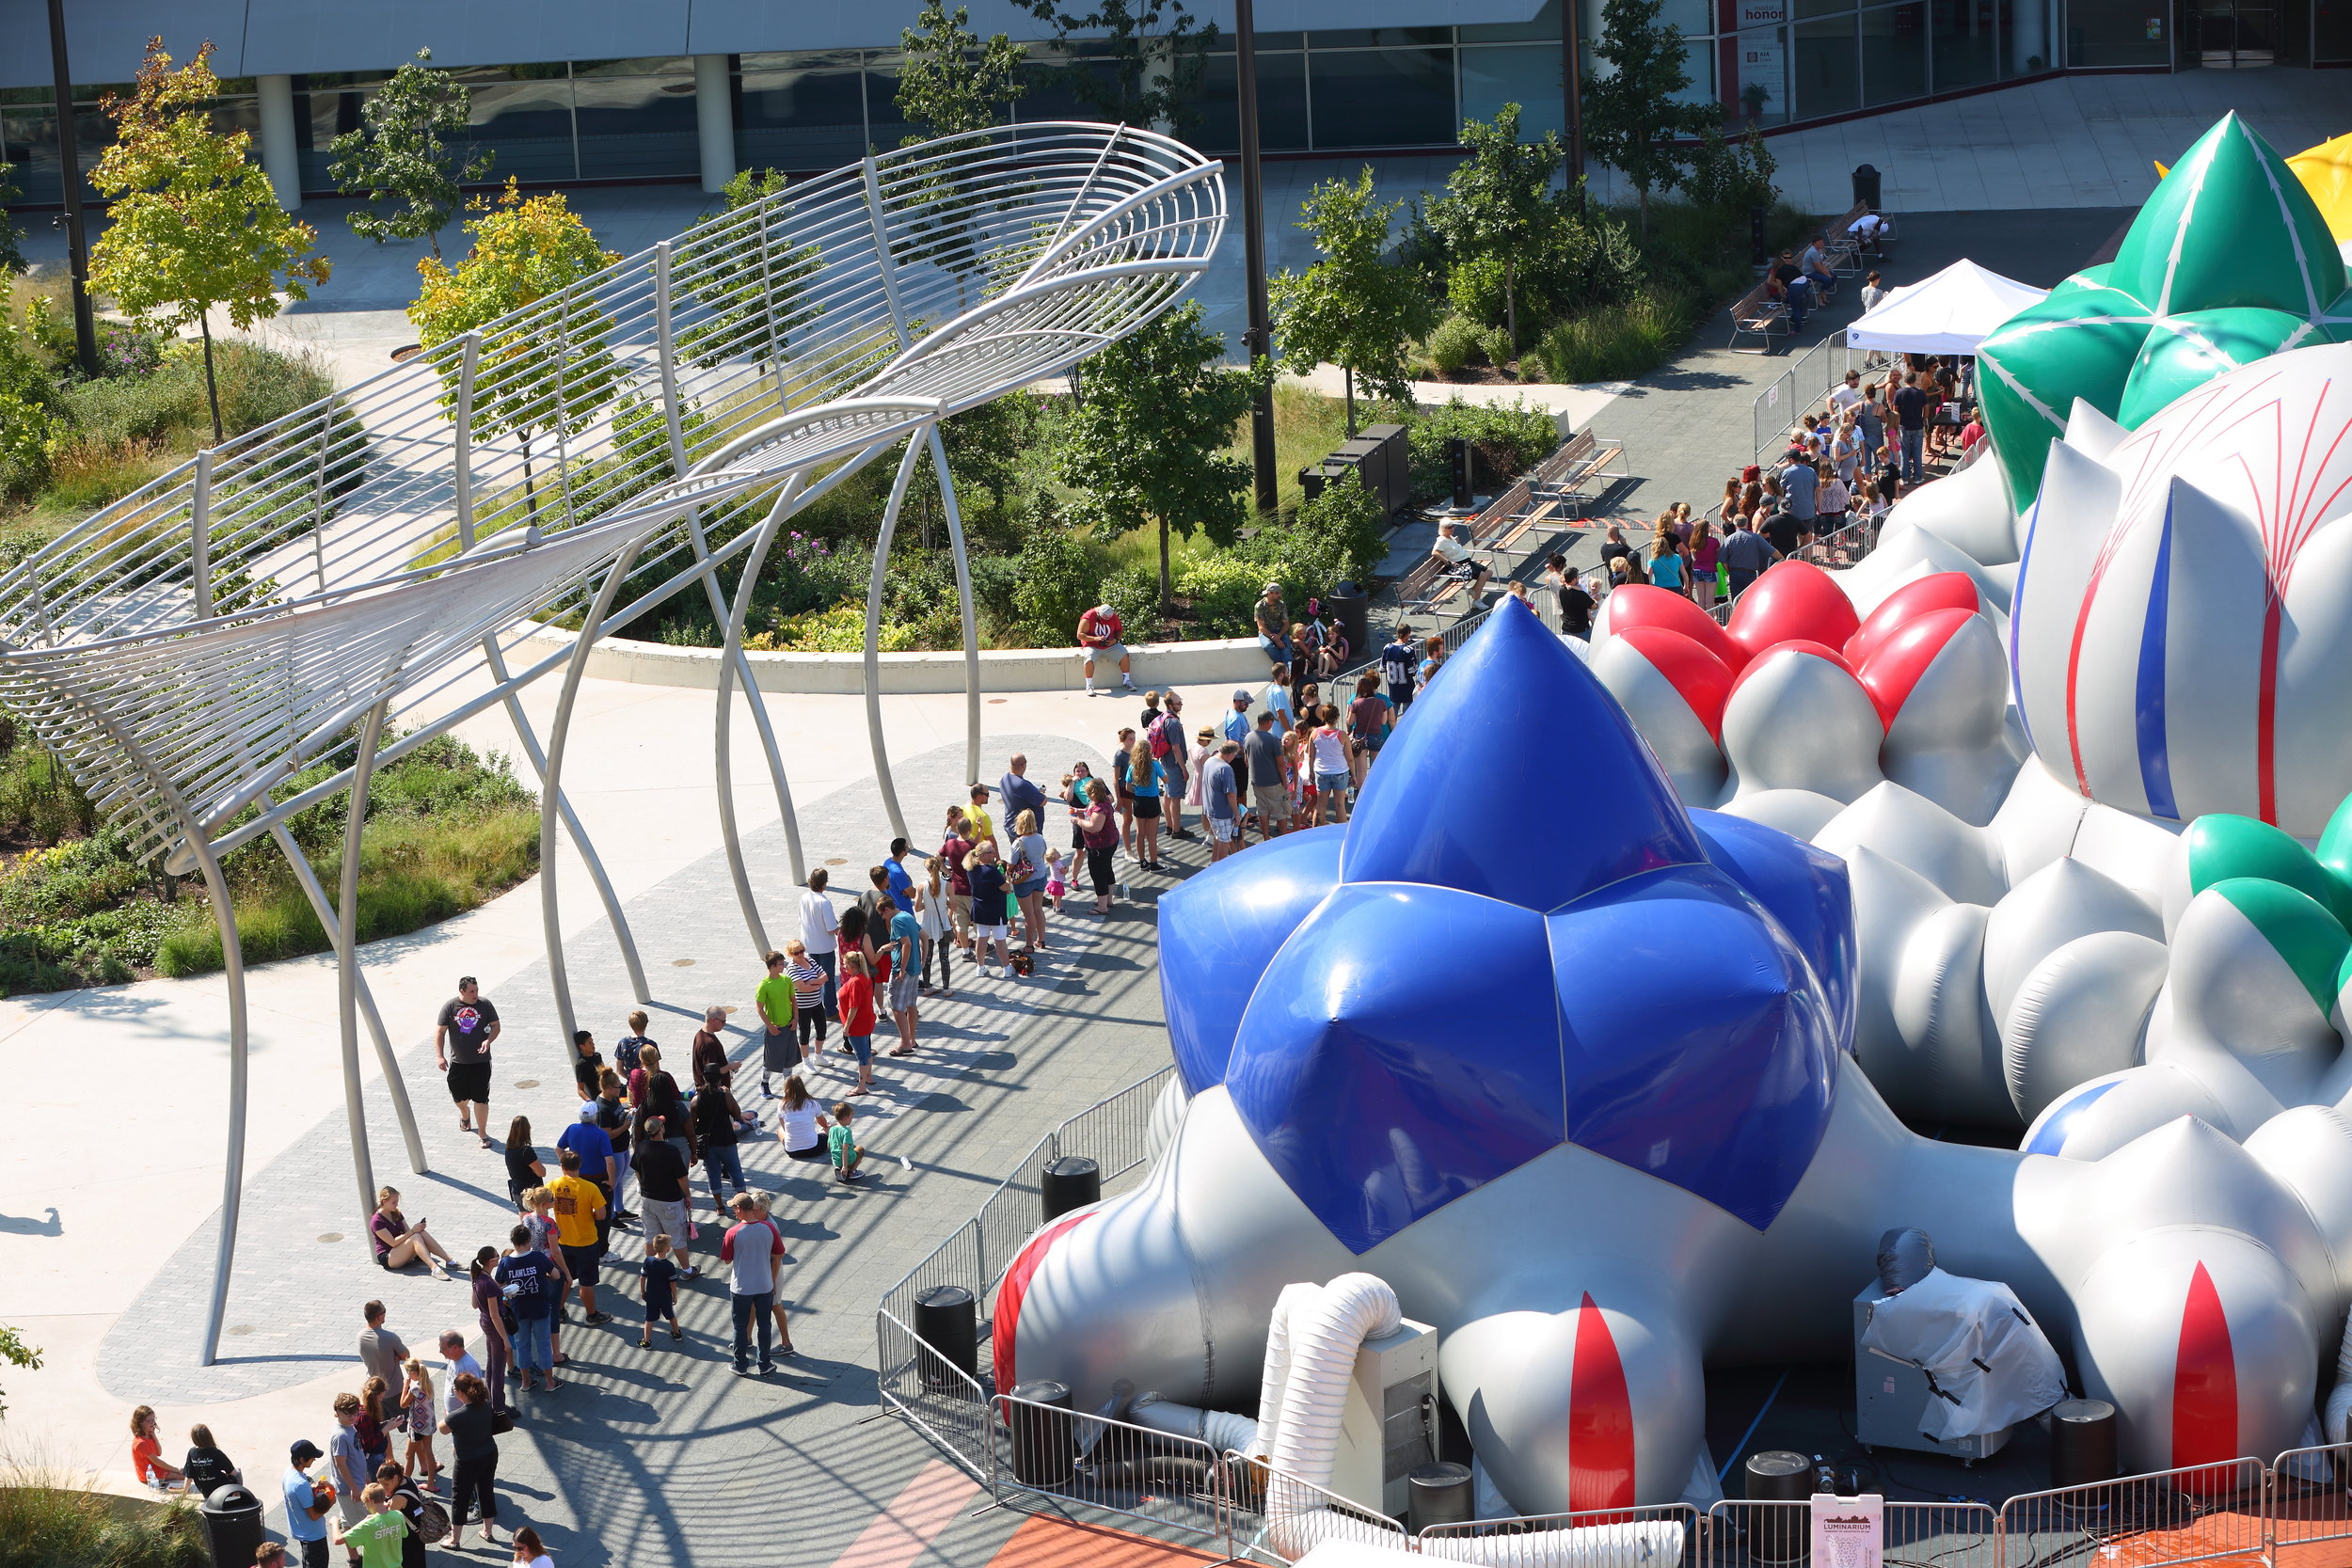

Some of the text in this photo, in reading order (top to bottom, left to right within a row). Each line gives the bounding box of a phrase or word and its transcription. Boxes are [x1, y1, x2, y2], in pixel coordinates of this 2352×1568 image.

[1746, 9, 1785, 20] honor
[635, 653, 687, 663] ABSENCE
[991, 658, 1043, 667] MARTIN
[1387, 661, 1407, 684] 81
[508, 1266, 536, 1278] FLAWLESS
[511, 1276, 538, 1295] 24
[375, 1525, 401, 1539] STAFF
